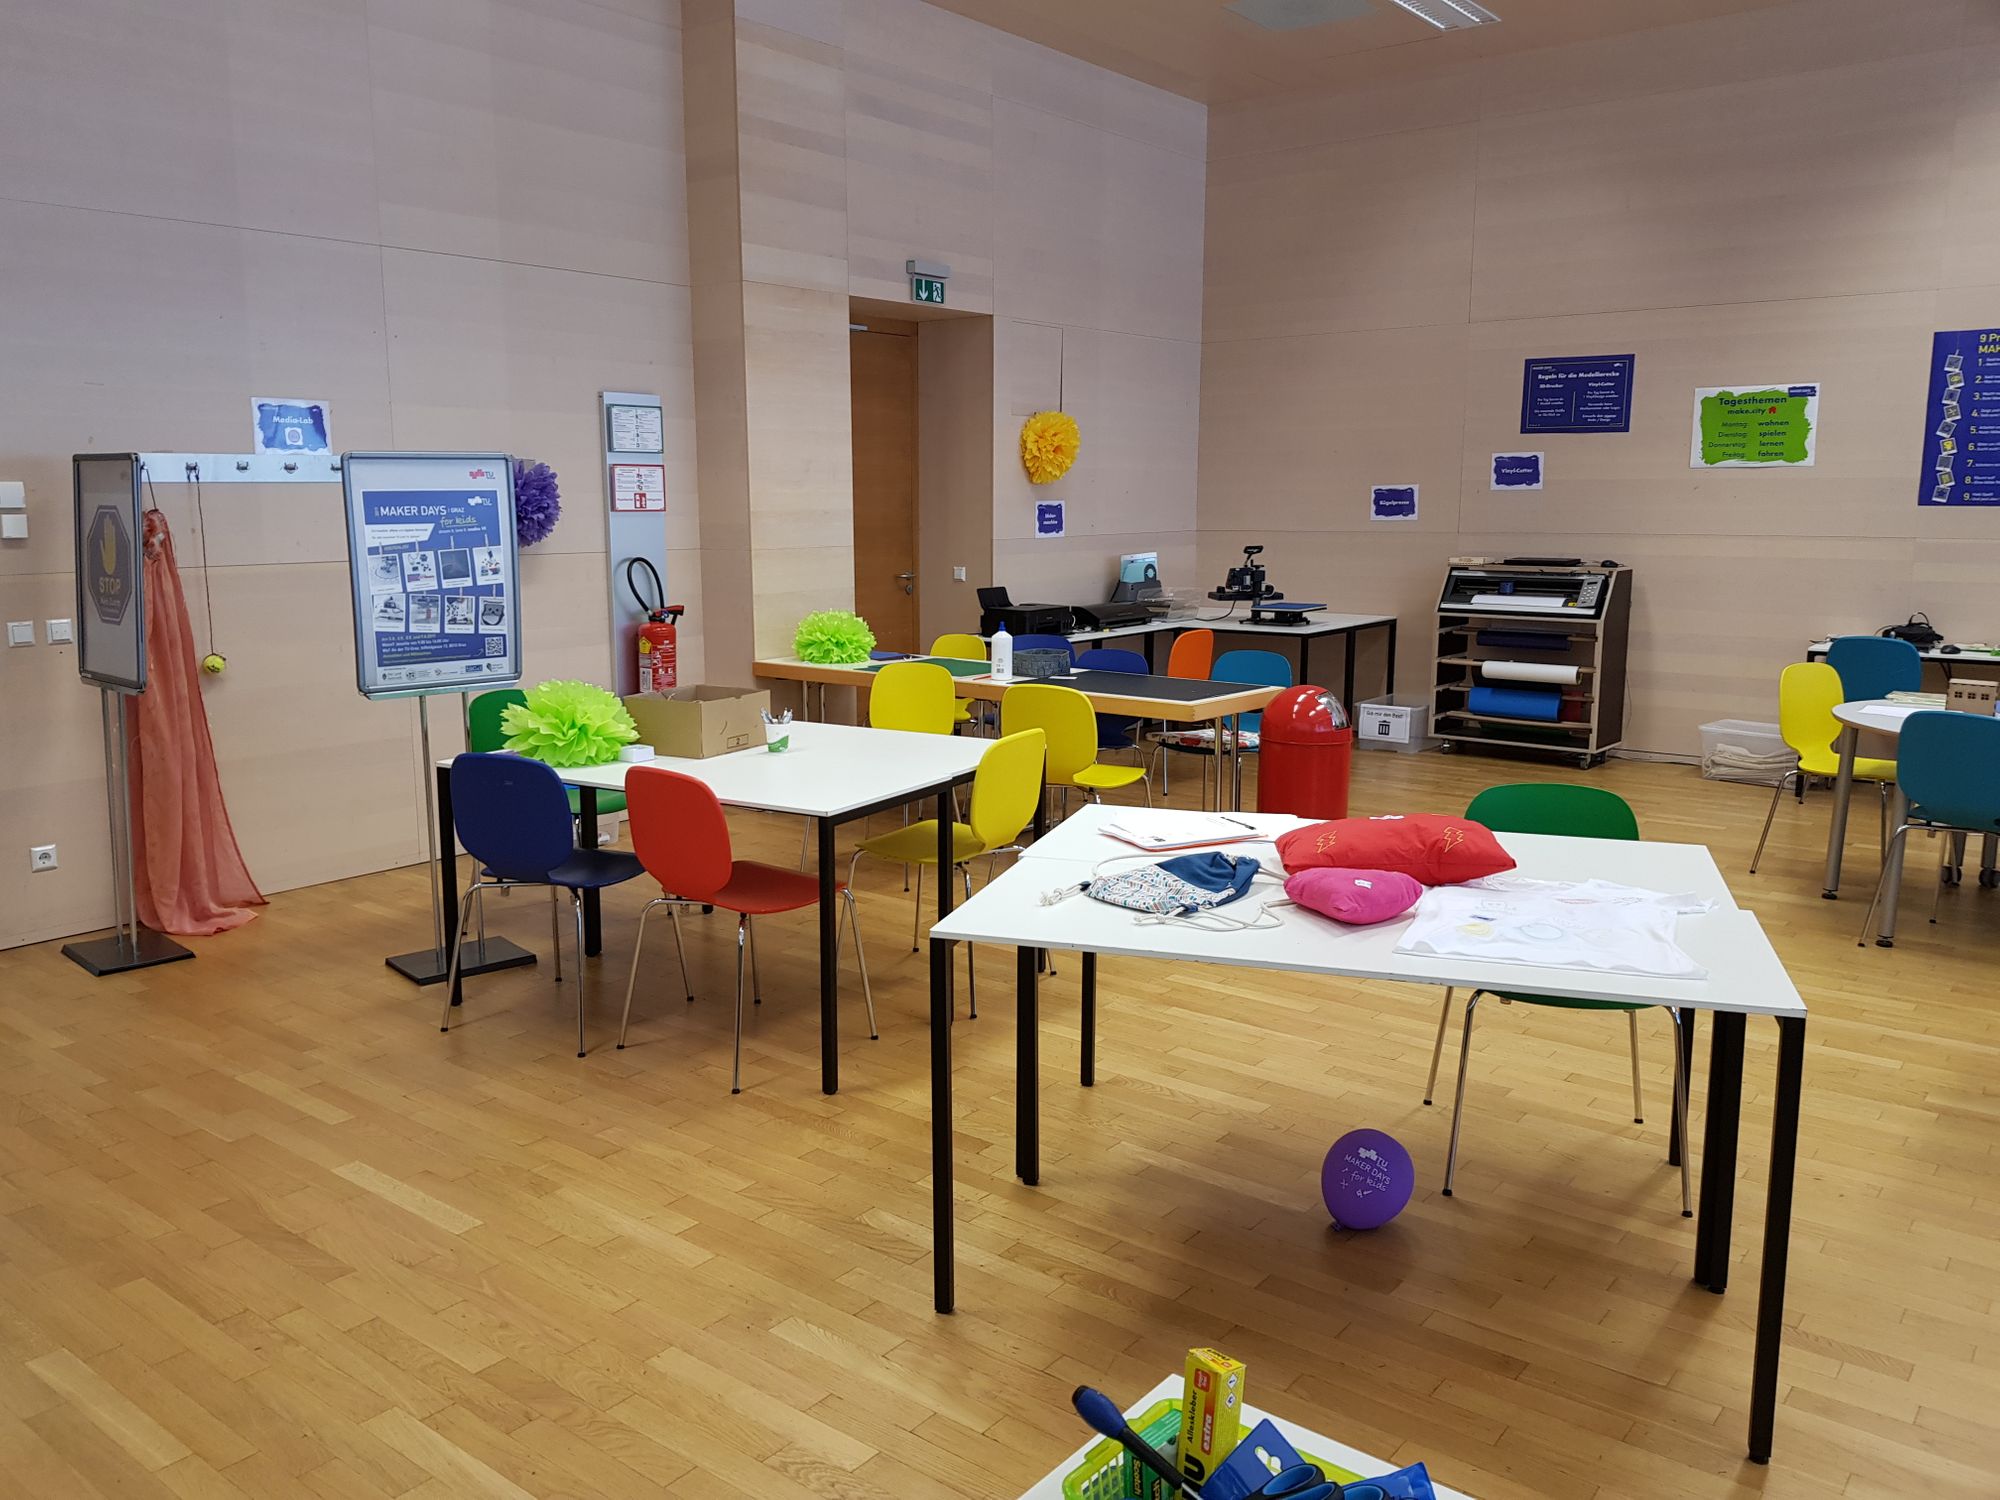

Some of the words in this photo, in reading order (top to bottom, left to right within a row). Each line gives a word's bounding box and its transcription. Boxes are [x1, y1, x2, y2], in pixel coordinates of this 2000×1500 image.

[1980, 334, 1987, 342] 9
[1718, 396, 1787, 407] Tagesthemen
[272, 416, 314, 424] Media-Lab
[380, 506, 418, 516] MAKER
[421, 505, 447, 516] DAYS
[440, 516, 453, 527] for
[456, 515, 477, 525] kids
[99, 576, 122, 595] STOP
[1344, 1154, 1370, 1172] MAKER
[1371, 1168, 1391, 1185] DAYS
[1376, 1157, 1388, 1167] TU
[1350, 1171, 1364, 1182] for
[1366, 1176, 1386, 1192] kids
[1187, 1390, 1198, 1444] Alleskleber
[1203, 1414, 1212, 1450] extra
[1133, 1459, 1142, 1495] Scotch
